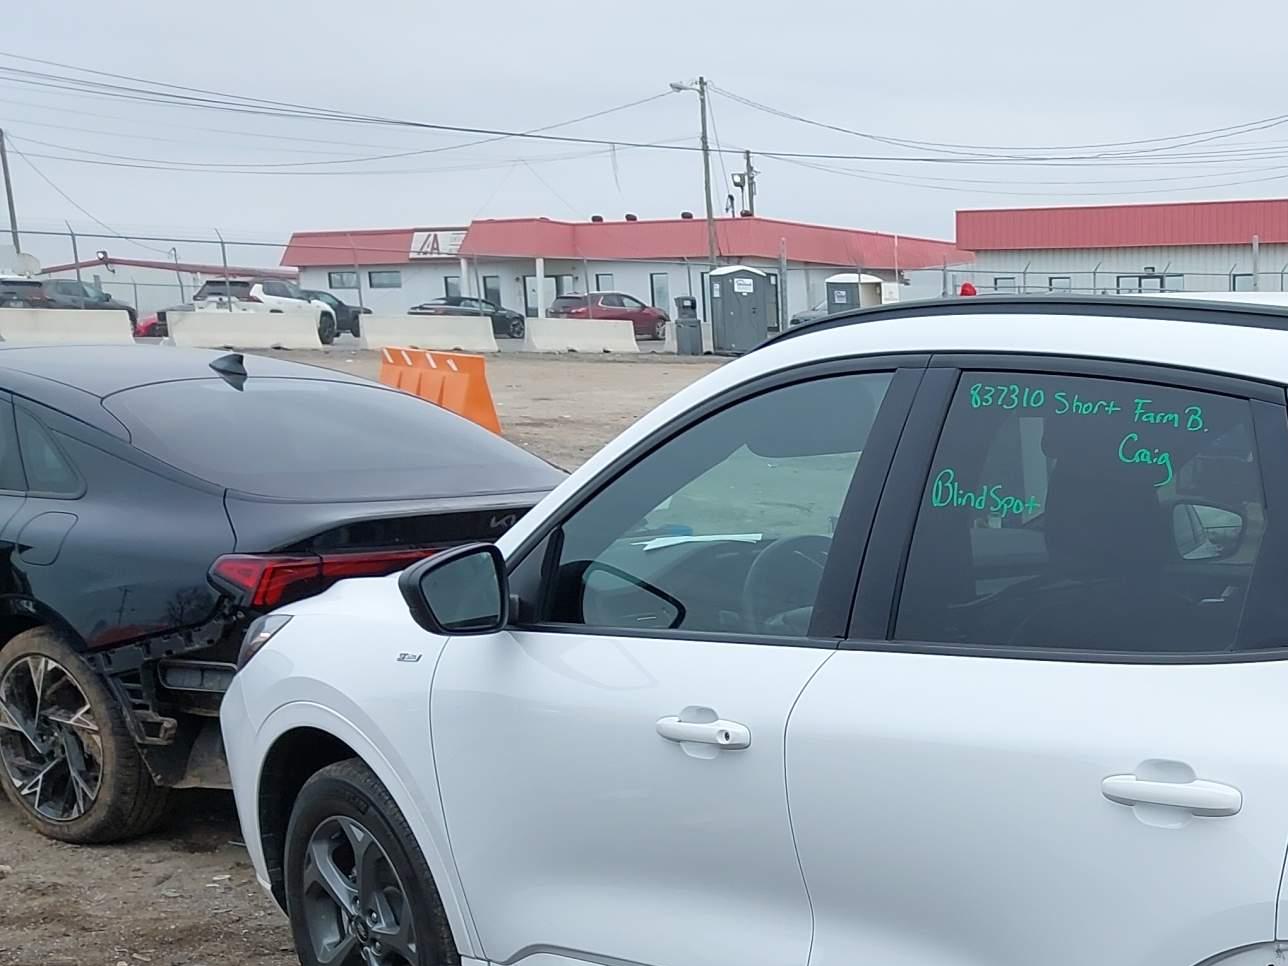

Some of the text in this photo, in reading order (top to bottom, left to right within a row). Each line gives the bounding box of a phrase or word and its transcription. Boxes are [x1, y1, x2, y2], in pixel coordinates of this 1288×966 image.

[970, 383, 1045, 410] 837310
[1054, 392, 1121, 415] Short
[1133, 399, 1179, 427] Farm
[1118, 433, 1174, 487] Craig
